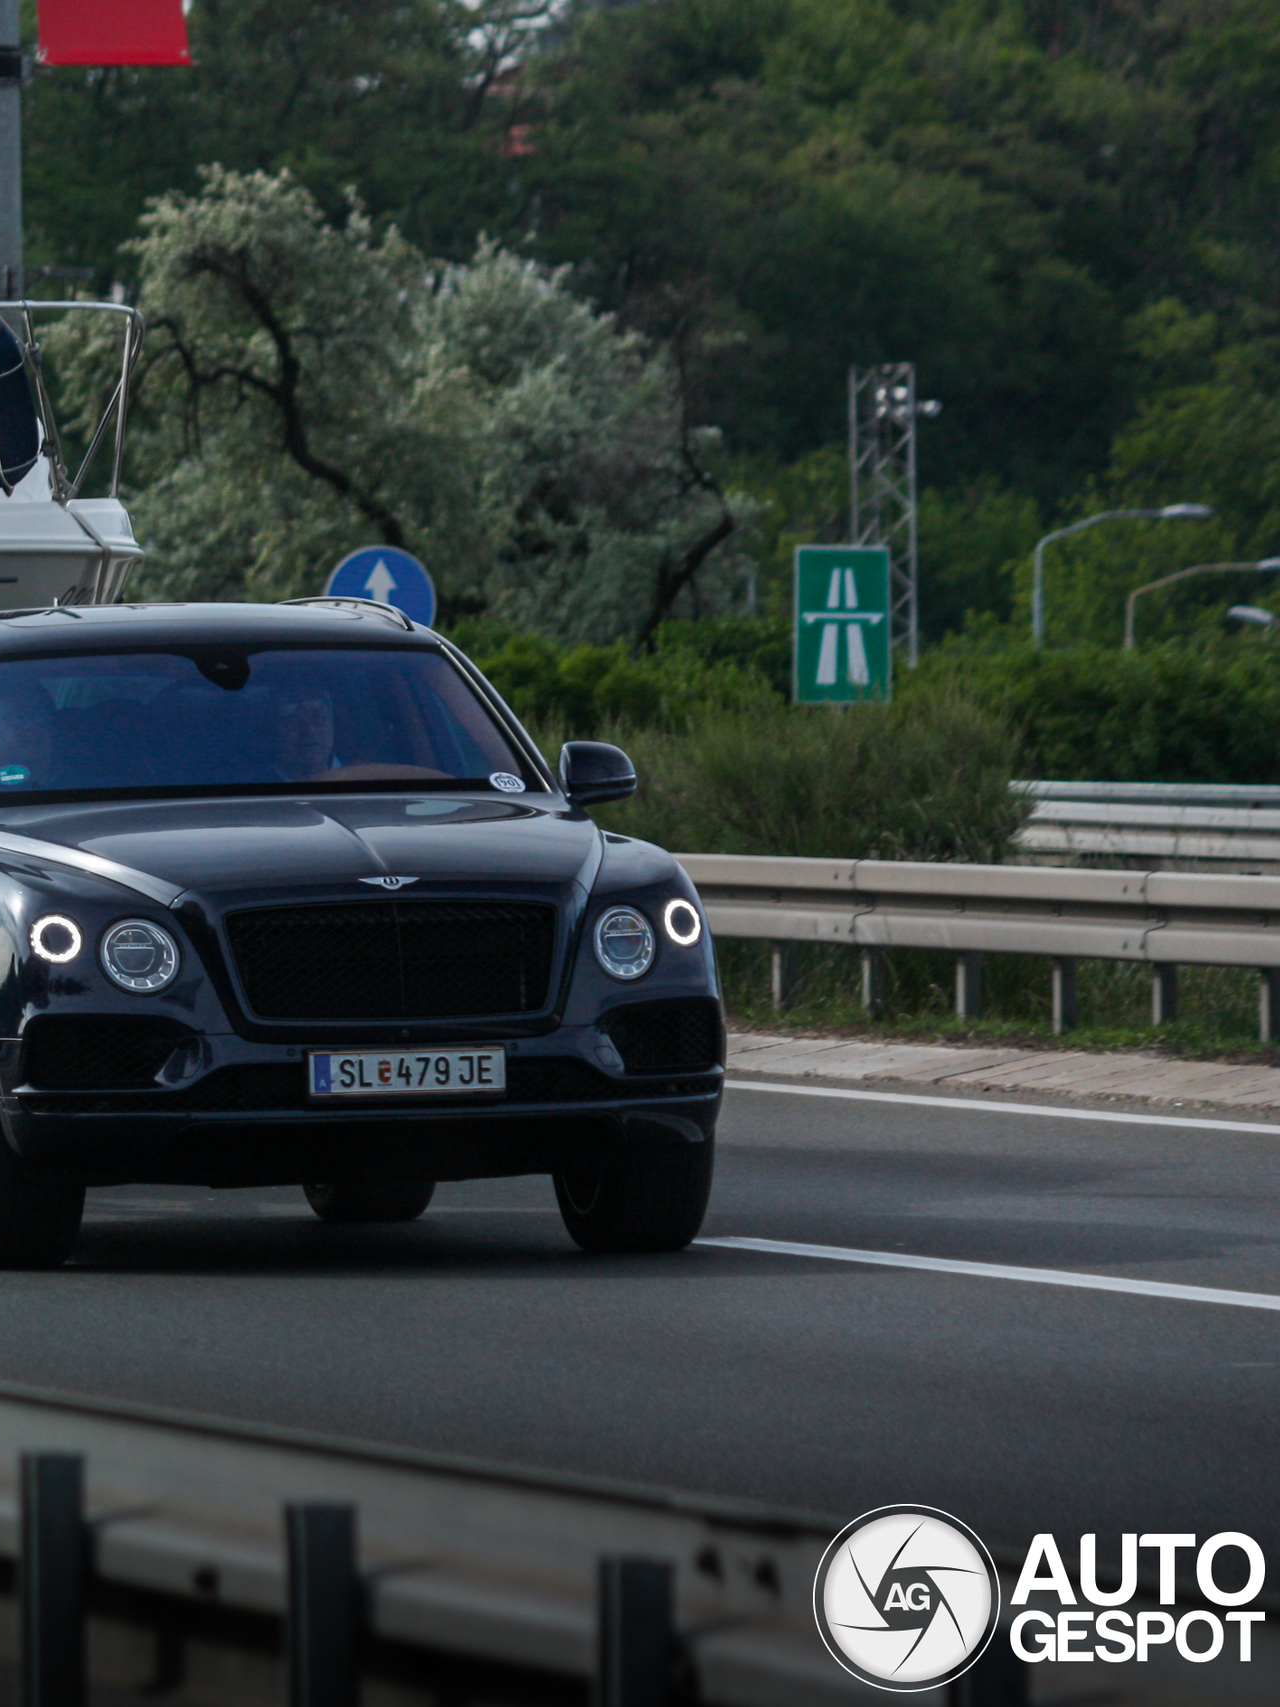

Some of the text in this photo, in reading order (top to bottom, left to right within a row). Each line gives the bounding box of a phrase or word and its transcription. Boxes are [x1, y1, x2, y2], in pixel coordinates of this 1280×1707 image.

[339, 1055, 492, 1088] SL 479 JE
